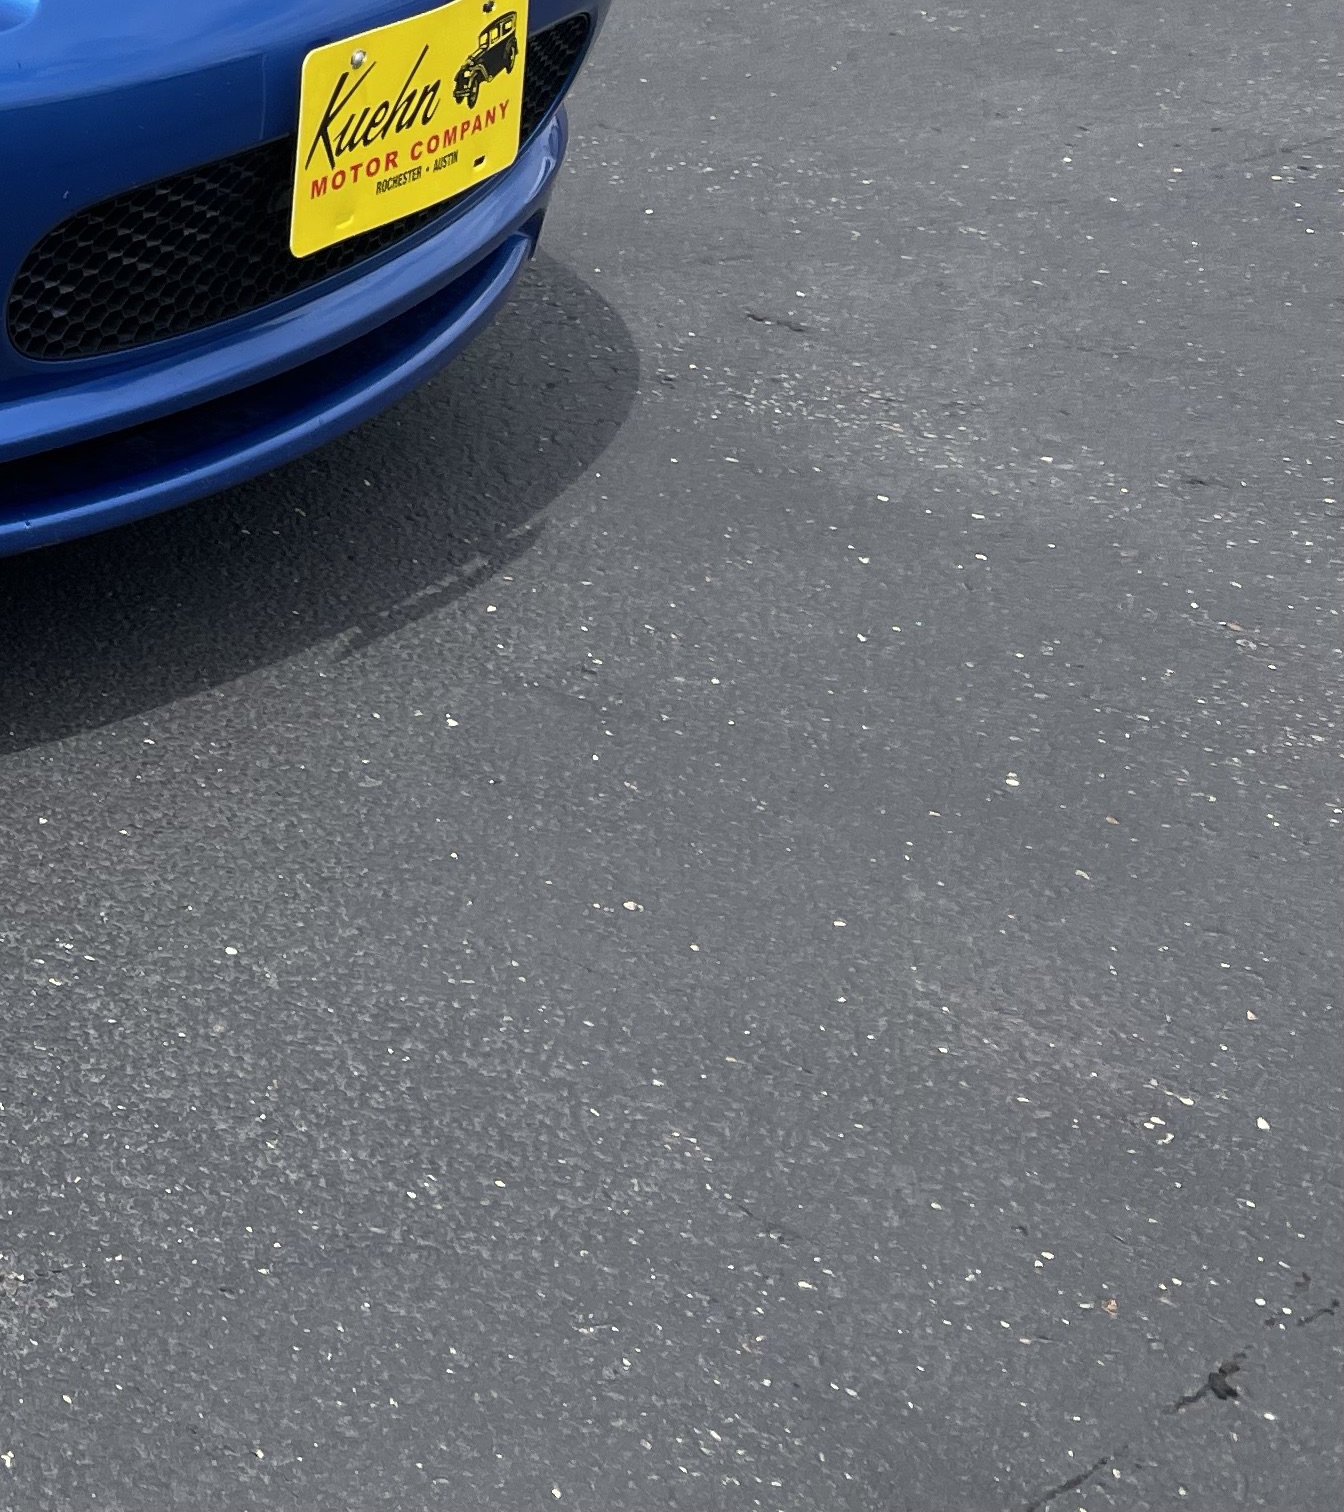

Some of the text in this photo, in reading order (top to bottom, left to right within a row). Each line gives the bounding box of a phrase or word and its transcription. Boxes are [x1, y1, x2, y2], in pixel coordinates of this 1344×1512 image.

[305, 44, 442, 171] Kuehn
[310, 99, 510, 200] MOTOR COMPANY
[376, 149, 459, 196] ROCHESTER AUSTIN
